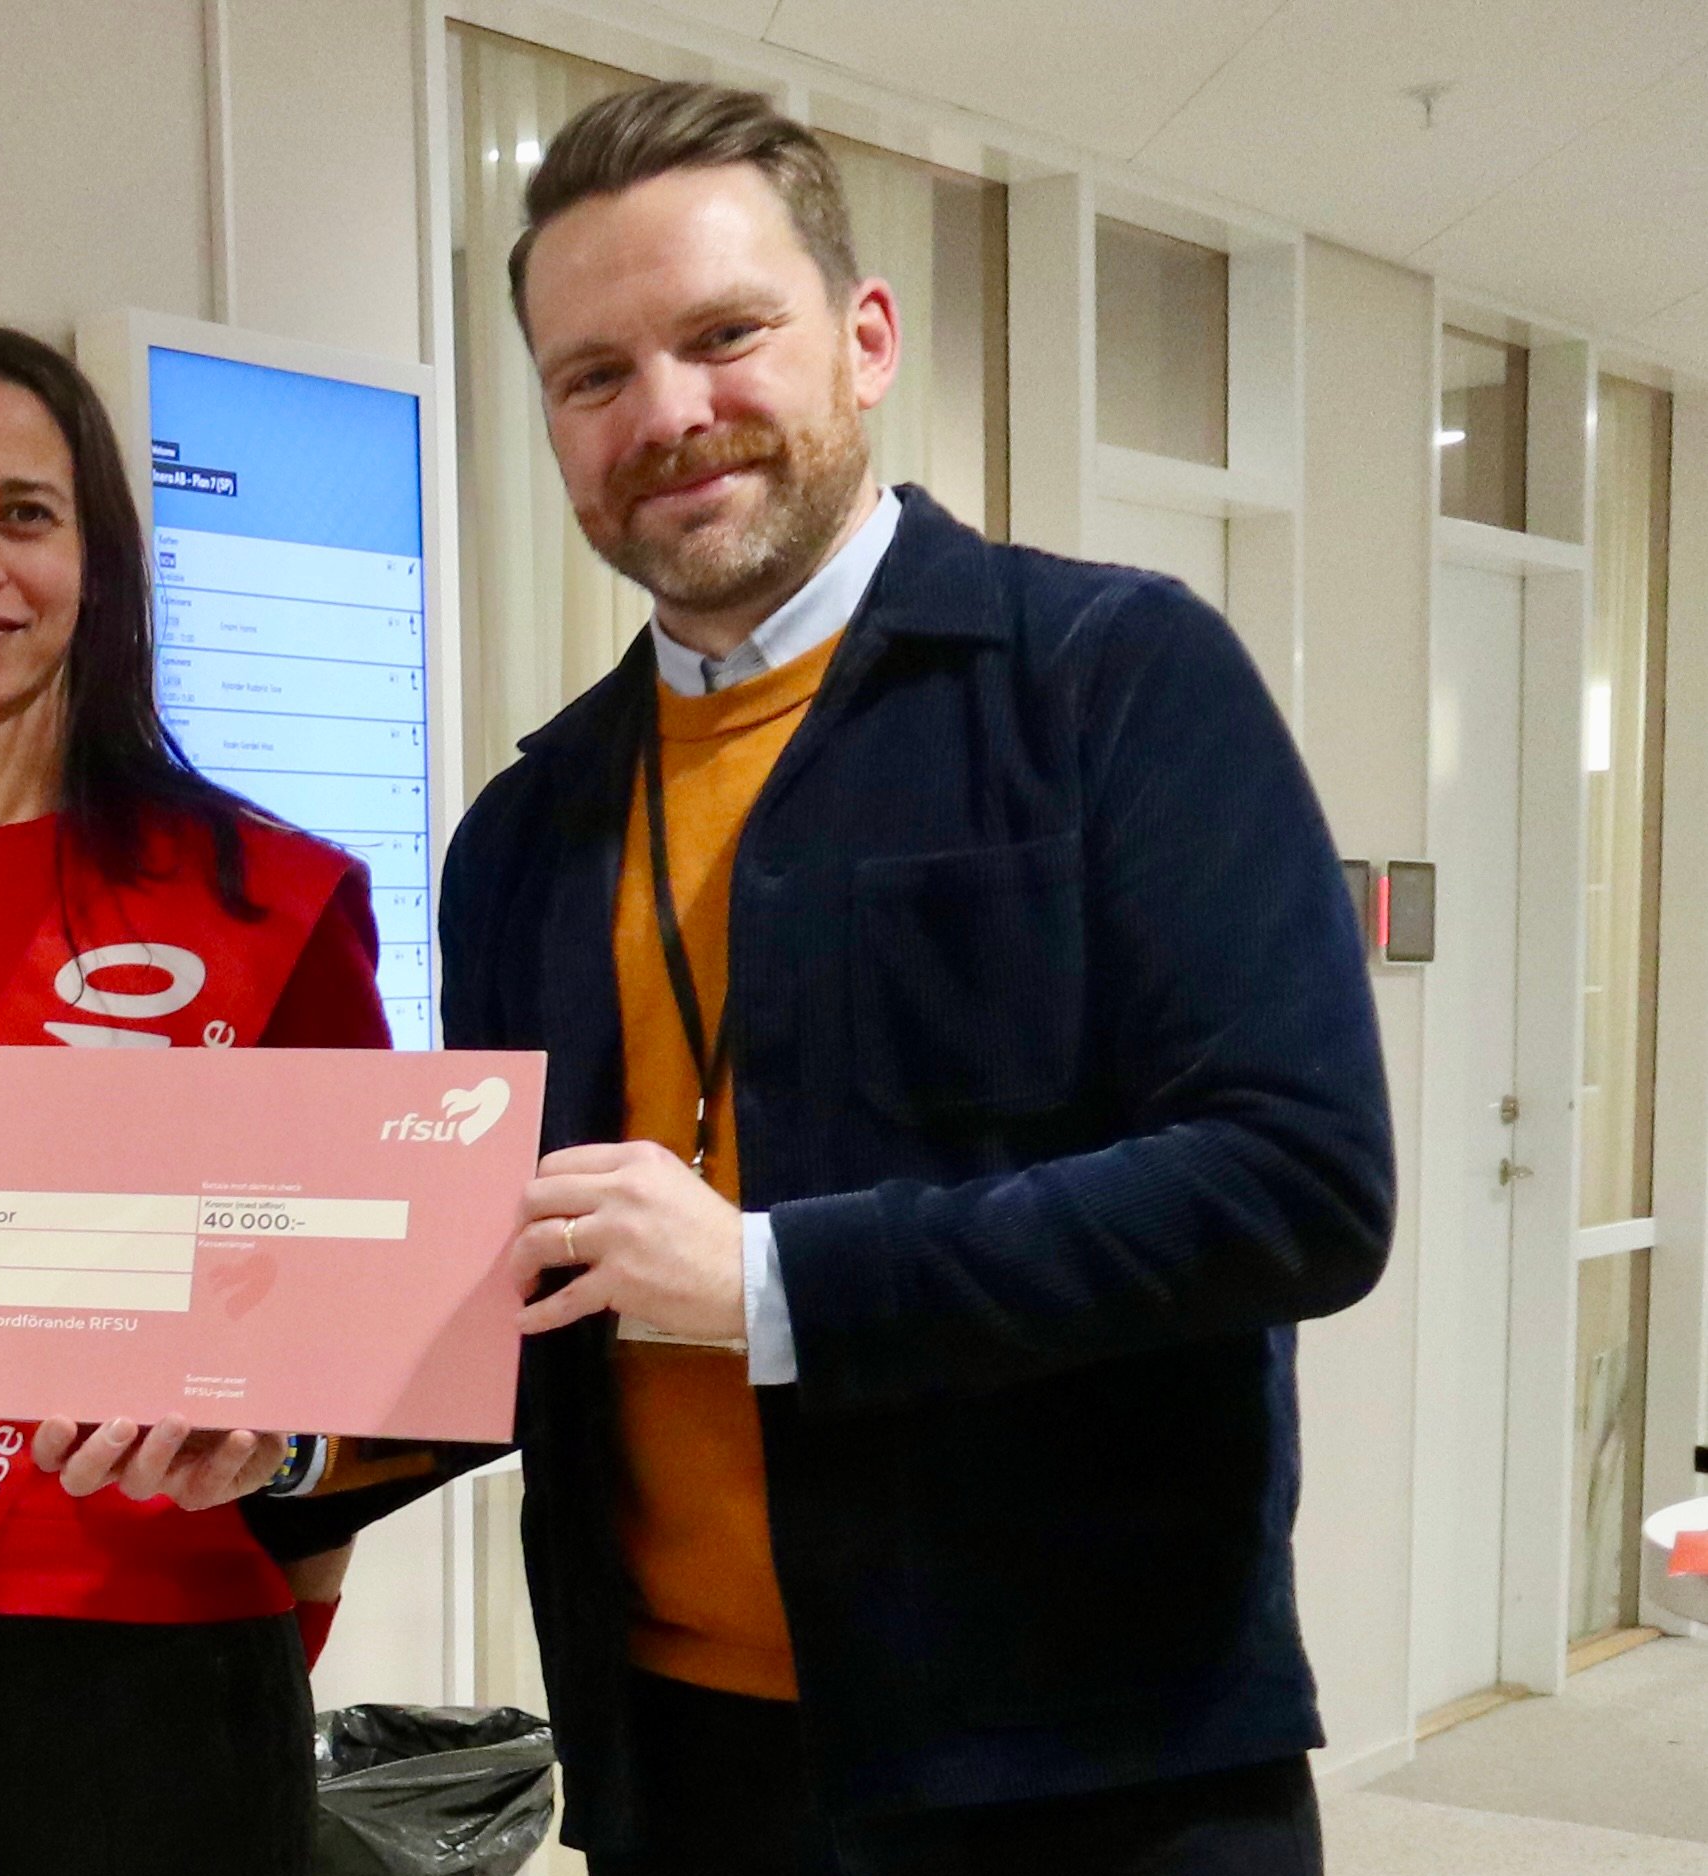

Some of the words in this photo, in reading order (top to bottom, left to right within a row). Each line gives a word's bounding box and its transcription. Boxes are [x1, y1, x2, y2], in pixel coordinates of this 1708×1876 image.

[381, 1112, 457, 1142] rfsu
[203, 1212, 234, 1228] 40
[240, 1213, 306, 1231] 000:-
[89, 1316, 139, 1332] RFSU
